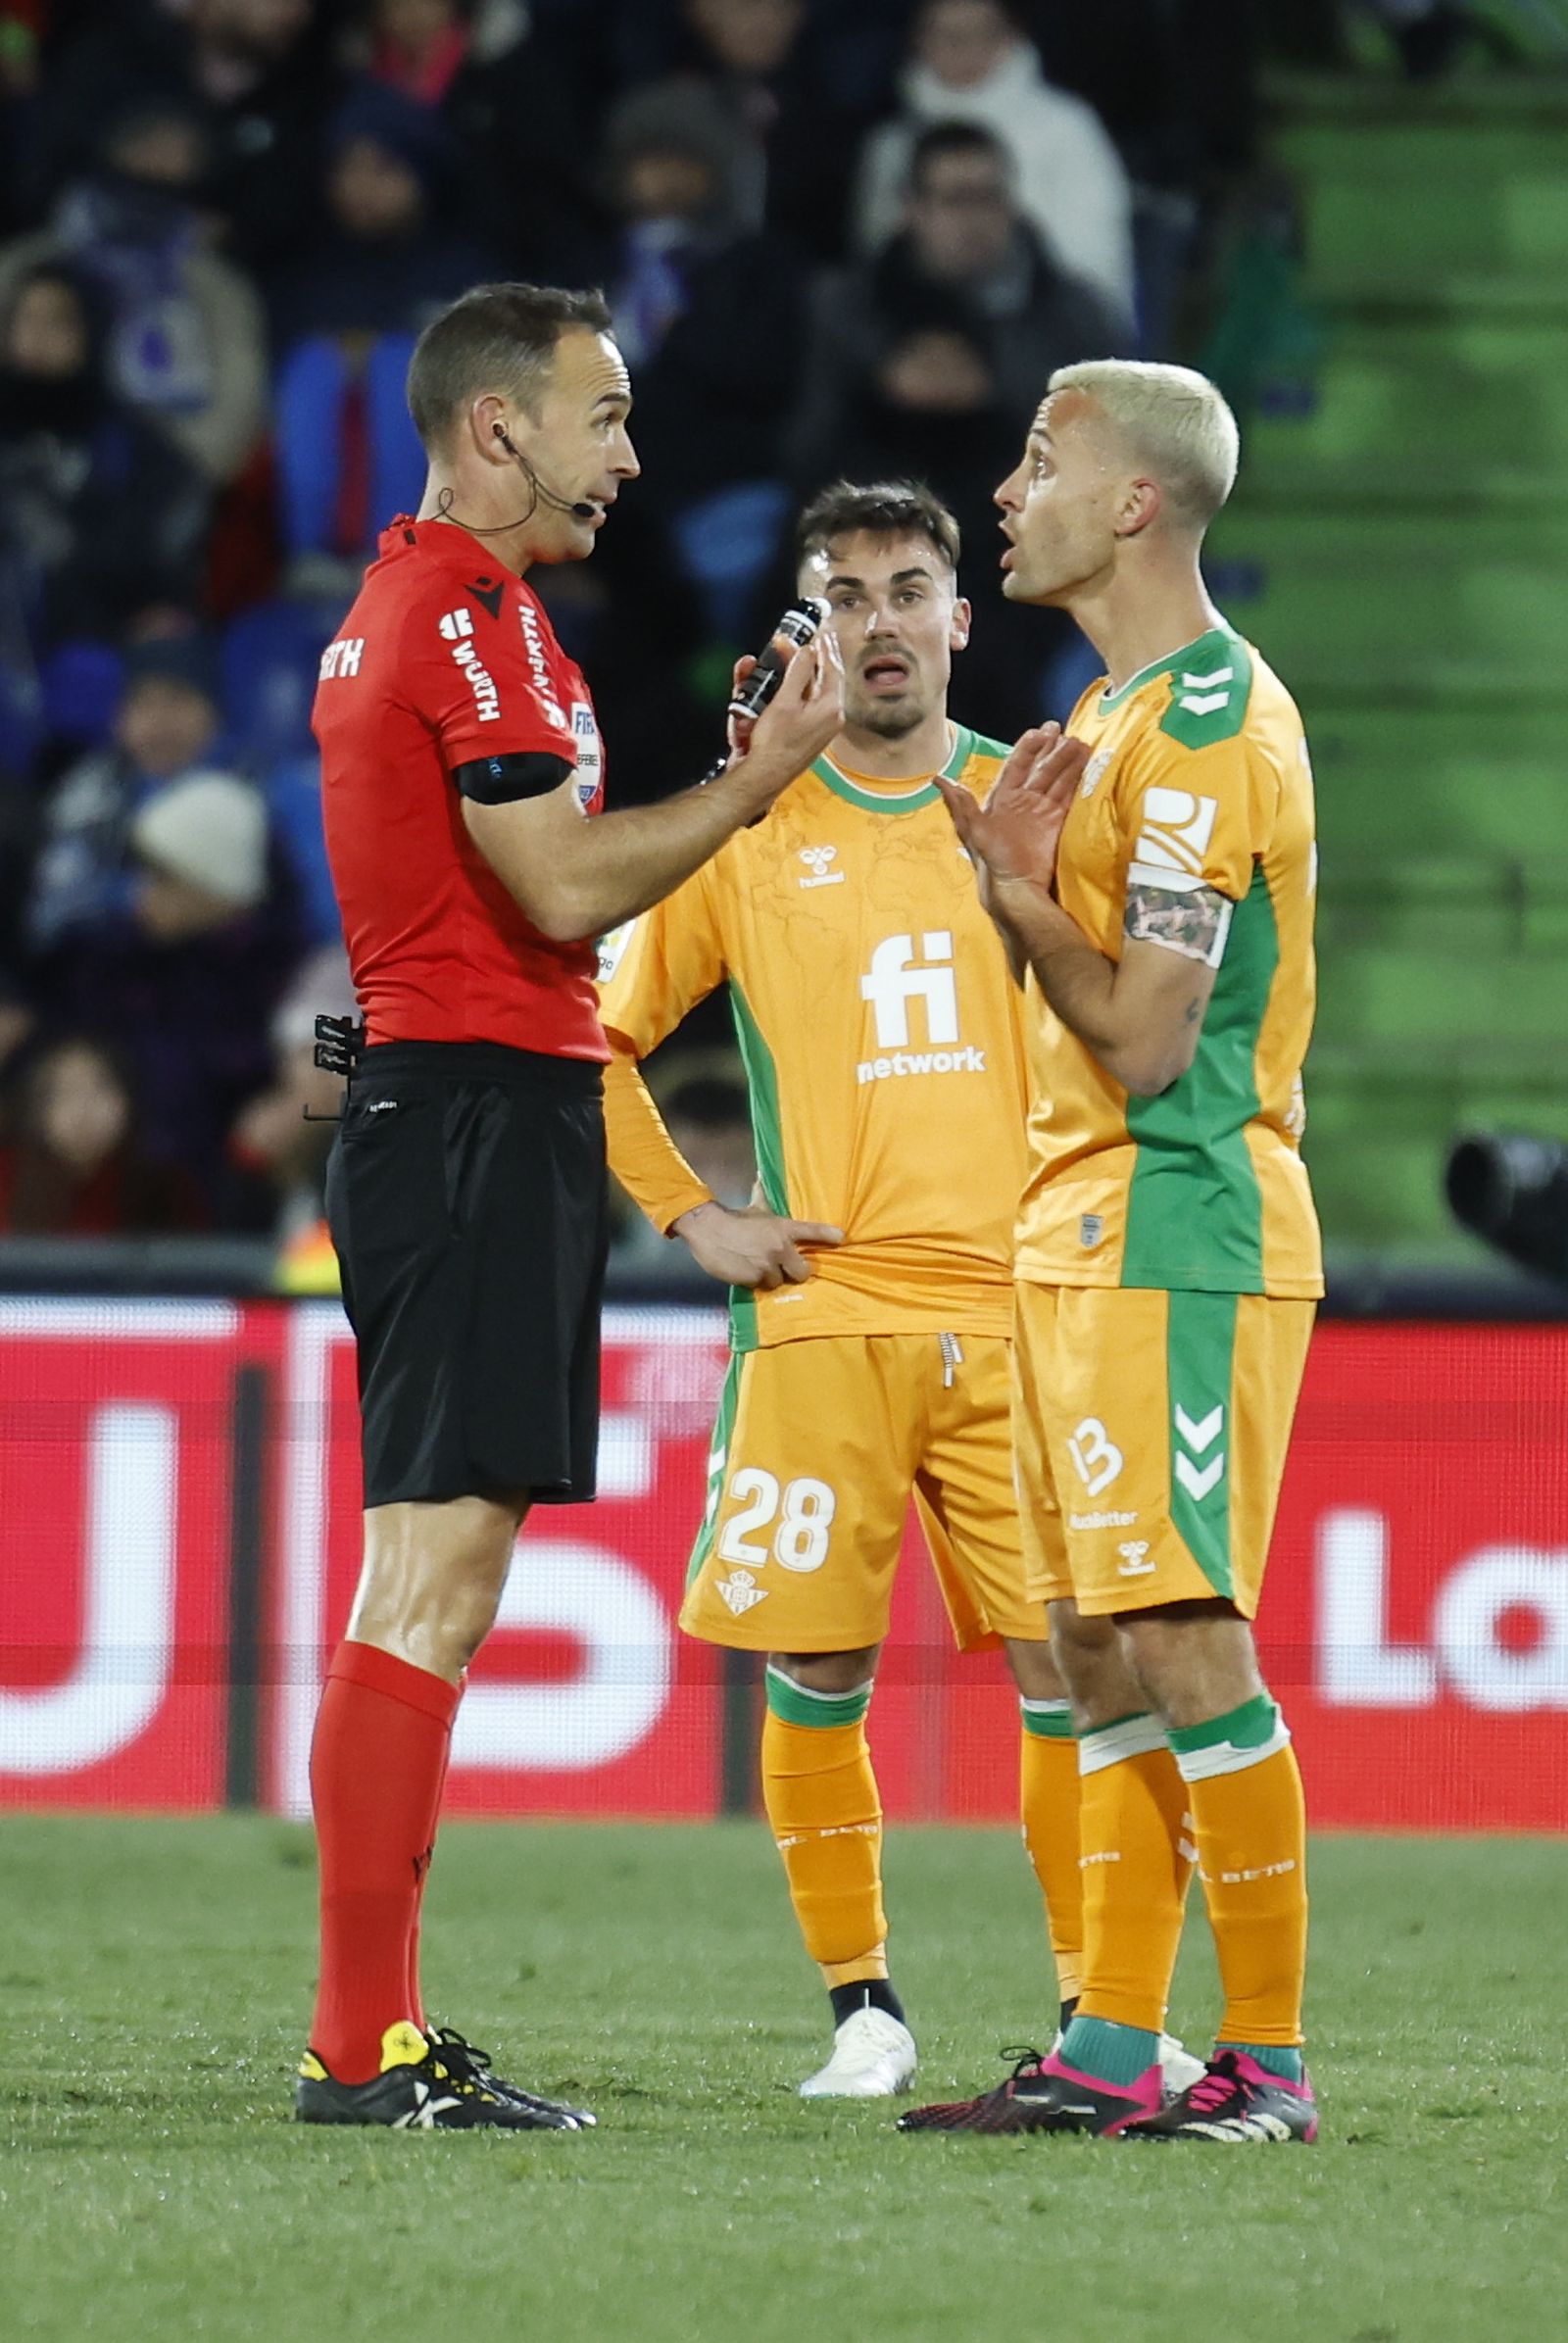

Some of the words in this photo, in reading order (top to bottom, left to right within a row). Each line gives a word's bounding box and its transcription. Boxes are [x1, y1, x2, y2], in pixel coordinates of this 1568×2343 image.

[318, 637, 366, 682] RTH
[861, 931, 959, 1049] fi
[857, 1046, 986, 1085] network
[717, 1467, 837, 1574] 28
